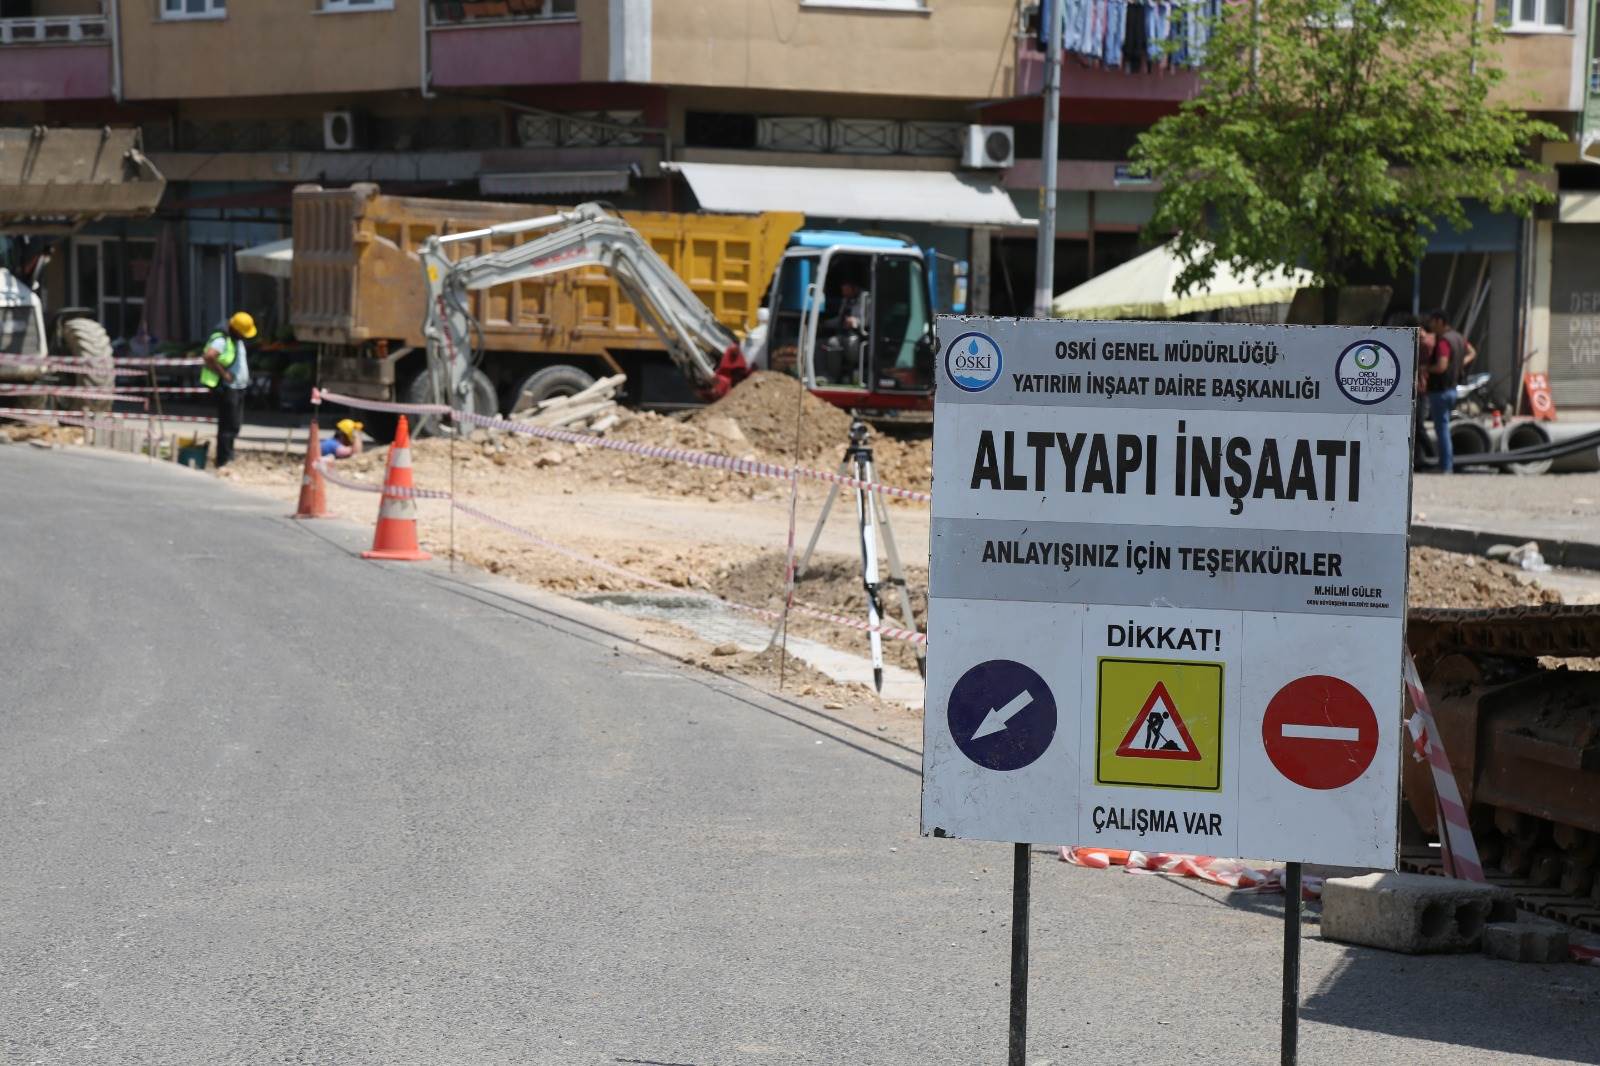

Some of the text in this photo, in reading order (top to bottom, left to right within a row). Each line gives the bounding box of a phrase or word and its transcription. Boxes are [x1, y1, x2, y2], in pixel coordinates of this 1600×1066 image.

[1055, 338, 1277, 364] OSKİ GENEL MÜDÜRLÜĞÜ
[1012, 371, 1320, 402] YATIRIM İNŞAAT DAİRE BAŞKANLIĞI
[970, 420, 1361, 515] ALTYAPI İNŞAATI
[982, 540, 1343, 577] ANLAYIŞINIZ İÇİN TEŞEKKÜRLER
[1351, 586, 1382, 598] GÜLER
[1107, 619, 1221, 652] DİKKAT!
[1092, 805, 1223, 837] ÇALIŞMA VAR
